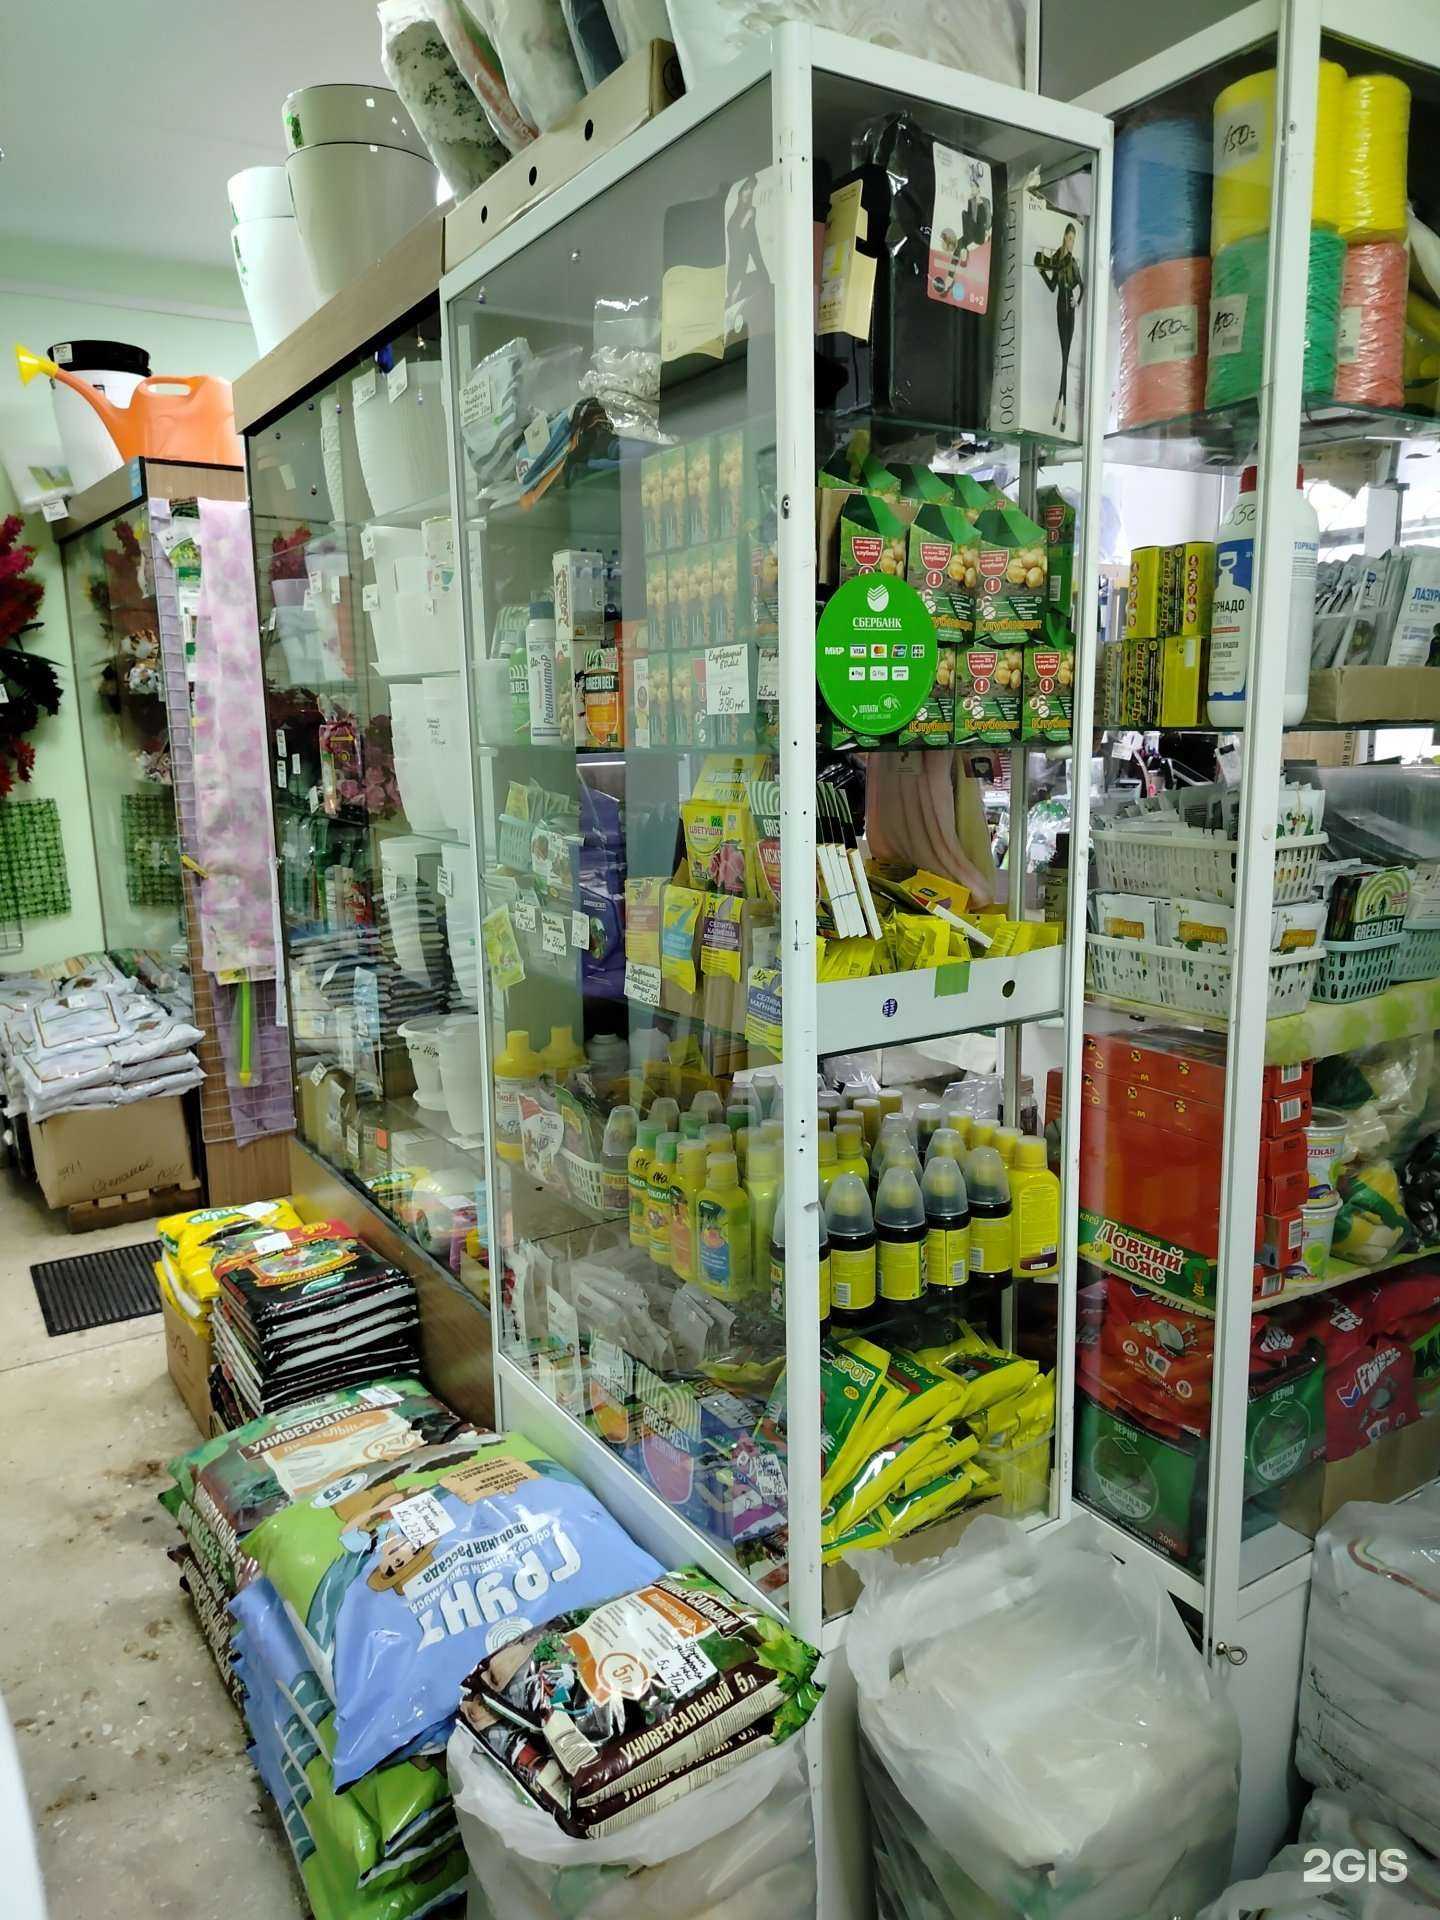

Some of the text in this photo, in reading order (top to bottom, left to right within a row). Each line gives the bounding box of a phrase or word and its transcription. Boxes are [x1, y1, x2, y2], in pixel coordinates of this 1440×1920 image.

[852, 616, 903, 629] СБЕРБАНК
[830, 1353, 876, 1387] КРОТ
[417, 1523, 582, 1652] ГРУНТ
[619, 1681, 734, 1761] УНИВЕРСАЛЬНЫЙ
